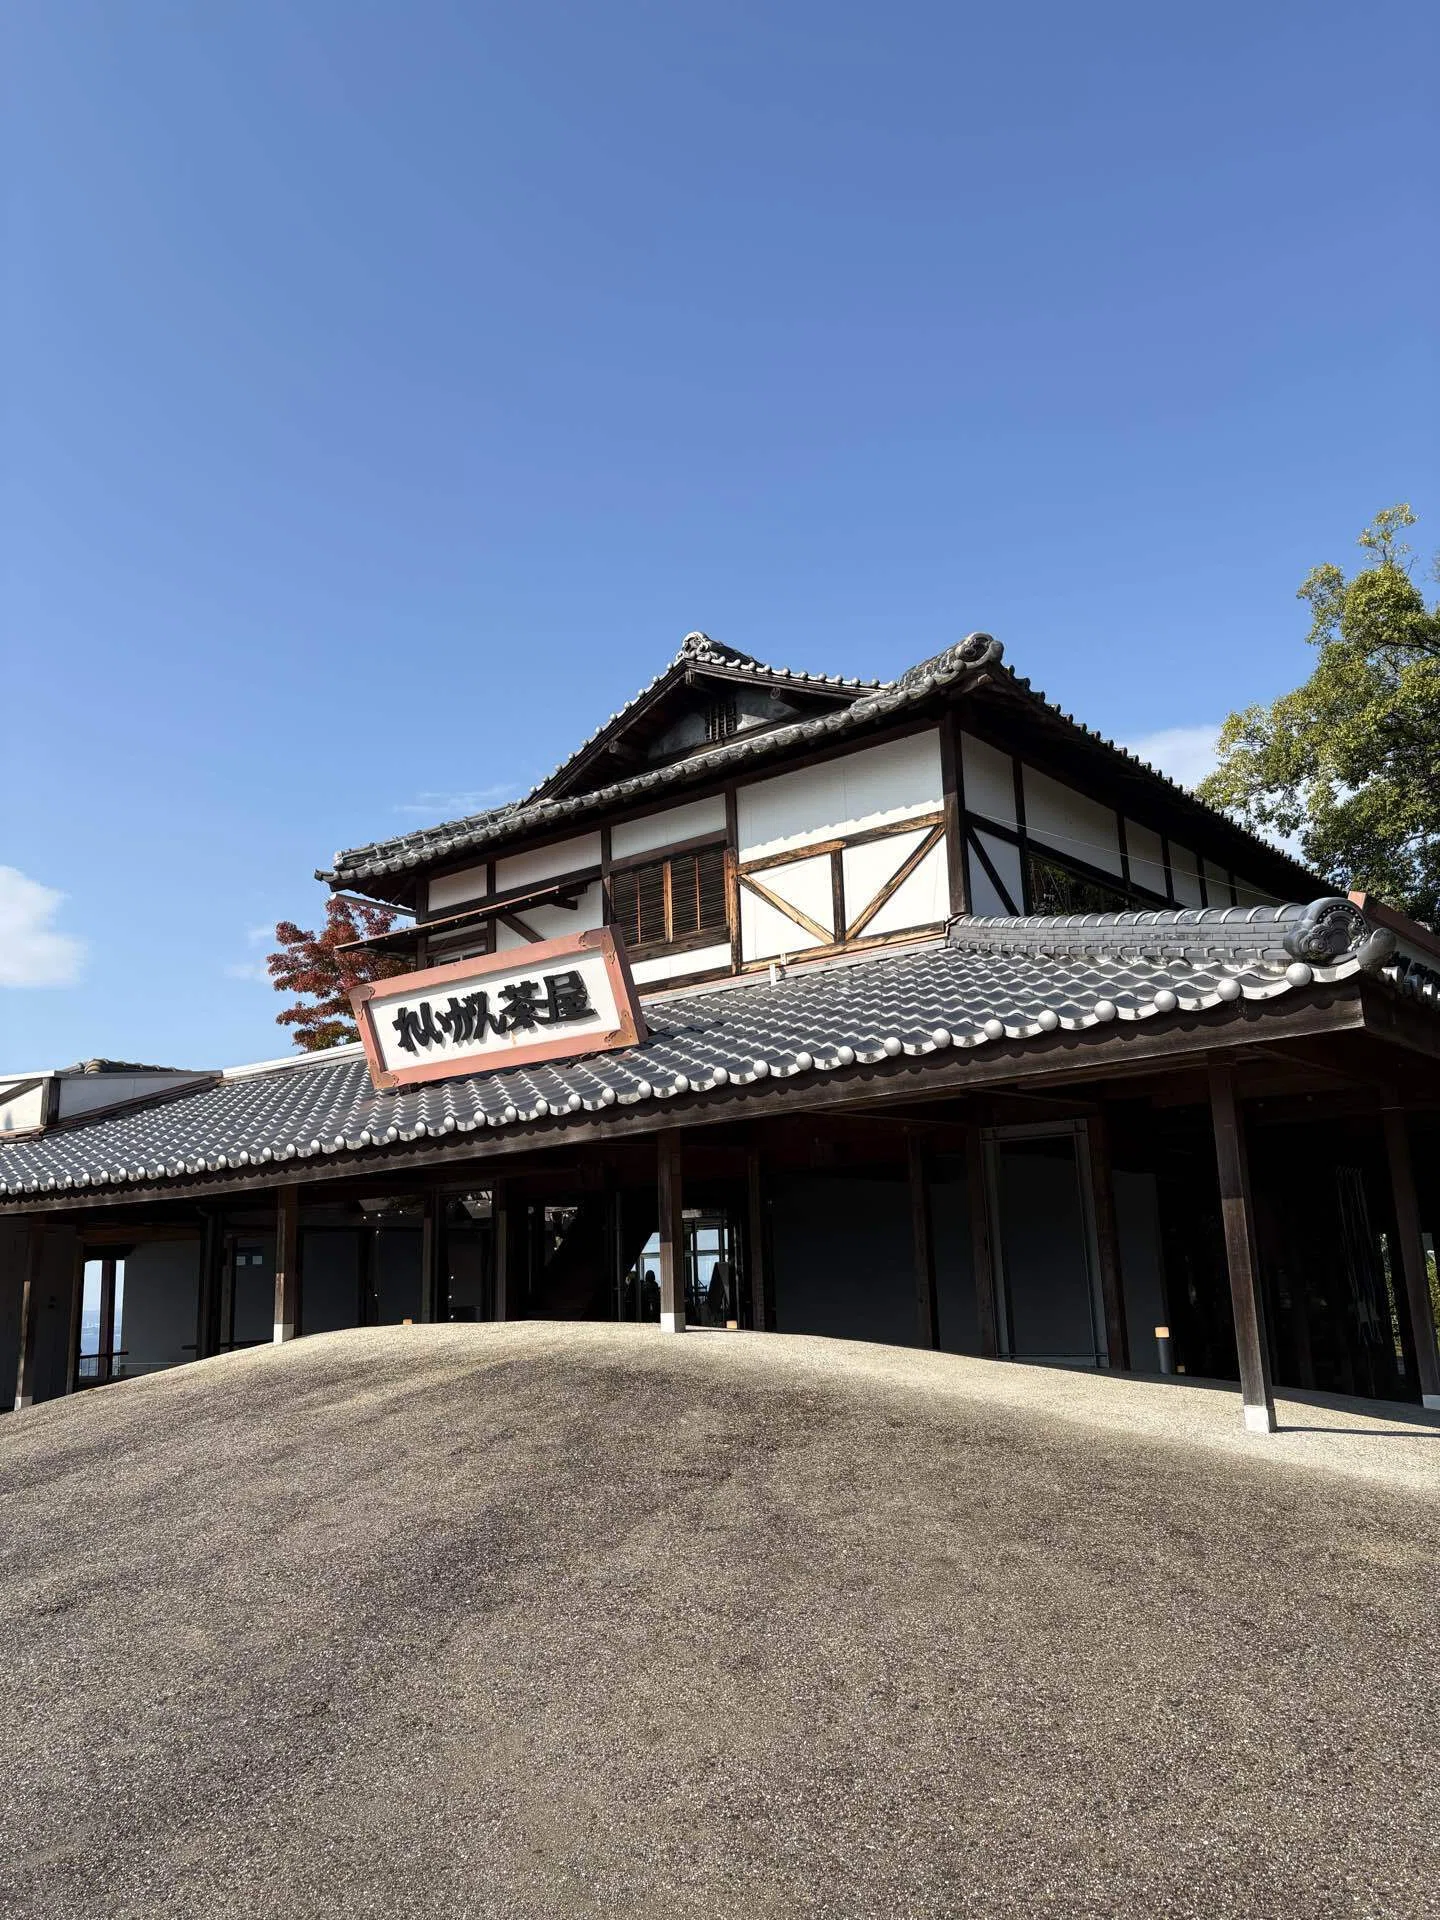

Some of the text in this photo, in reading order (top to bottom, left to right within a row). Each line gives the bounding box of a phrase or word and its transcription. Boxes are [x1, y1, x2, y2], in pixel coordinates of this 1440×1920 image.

[391, 969, 598, 1052] れいがん茶屋
